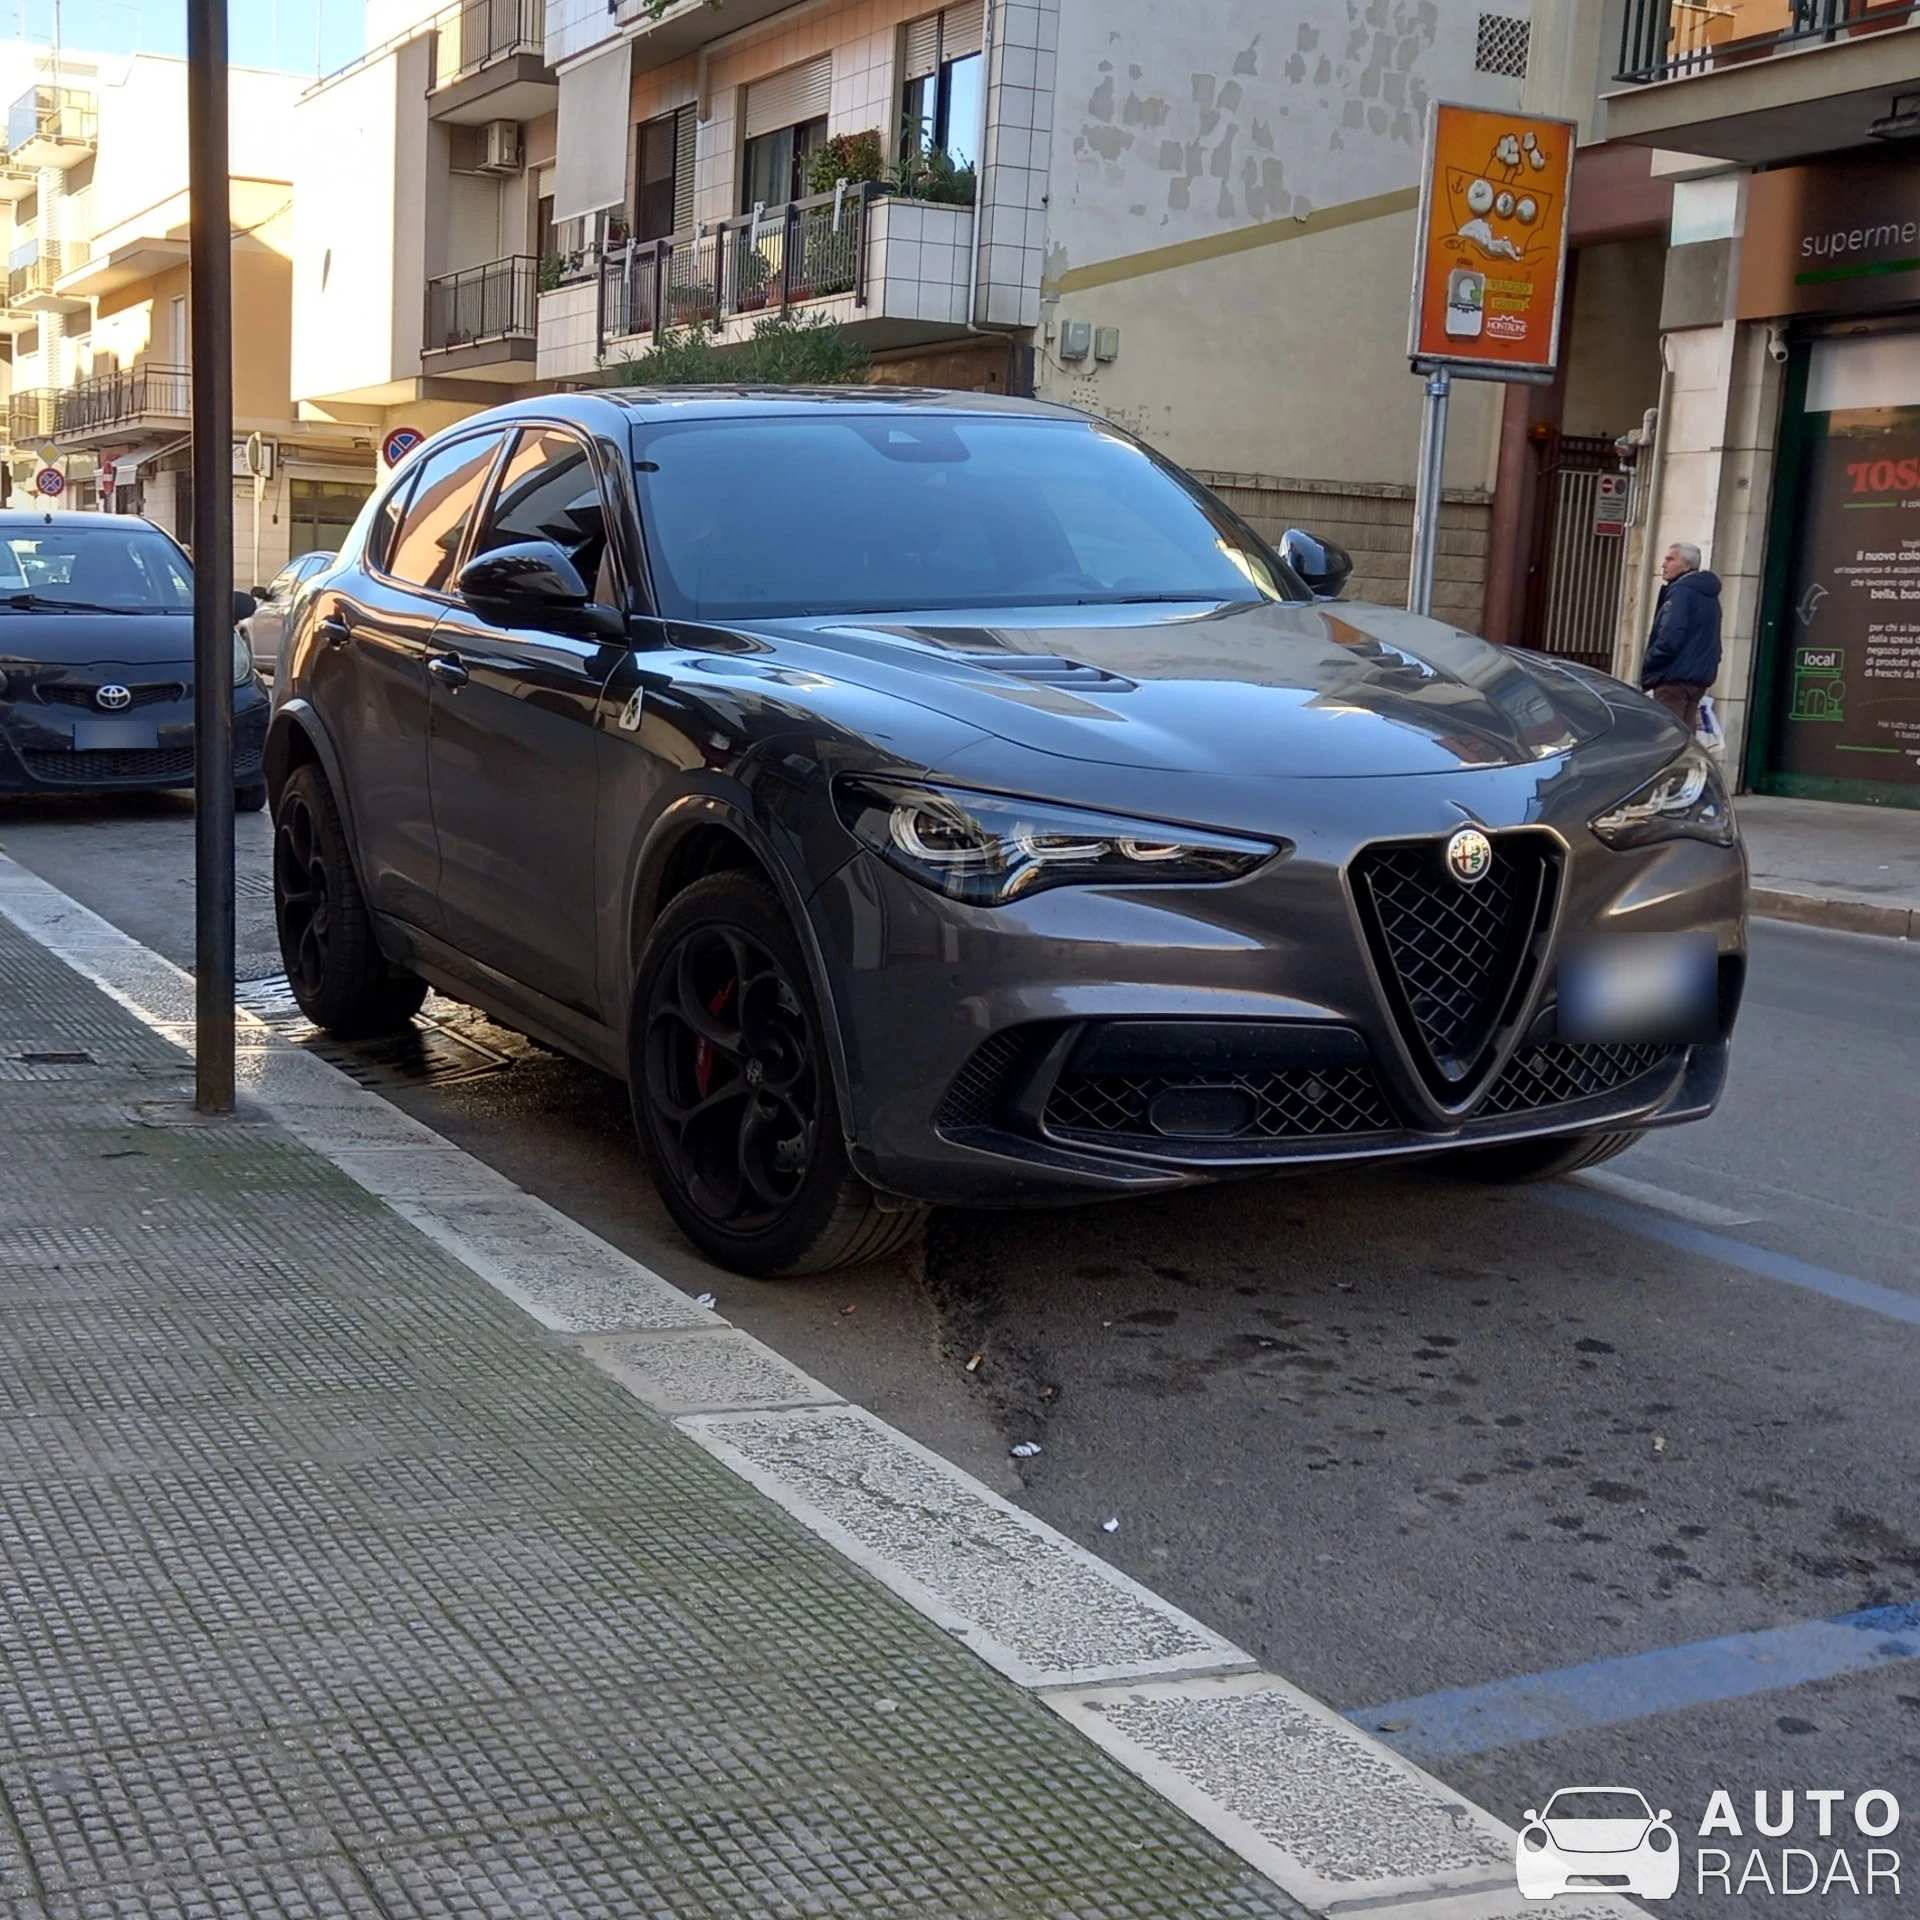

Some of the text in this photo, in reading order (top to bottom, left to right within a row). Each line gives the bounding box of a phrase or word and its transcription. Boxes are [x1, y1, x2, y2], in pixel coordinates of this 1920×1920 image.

[1801, 222, 1920, 258] superme
[1847, 458, 1920, 493] TOS
[1865, 552, 1897, 561] nuovo
[1871, 588, 1898, 600] bella,
[1869, 624, 1884, 633] per
[1885, 622, 1898, 632] chi
[1868, 634, 1888, 643] dalla
[1890, 636, 1913, 644] spesa
[1867, 646, 1900, 656] negozio
[1804, 651, 1836, 666] local
[1865, 656, 1874, 666] di
[1875, 658, 1909, 667] prodotti
[1864, 667, 1873, 677] di
[1874, 667, 1902, 678] freschi
[1903, 669, 1915, 679] da
